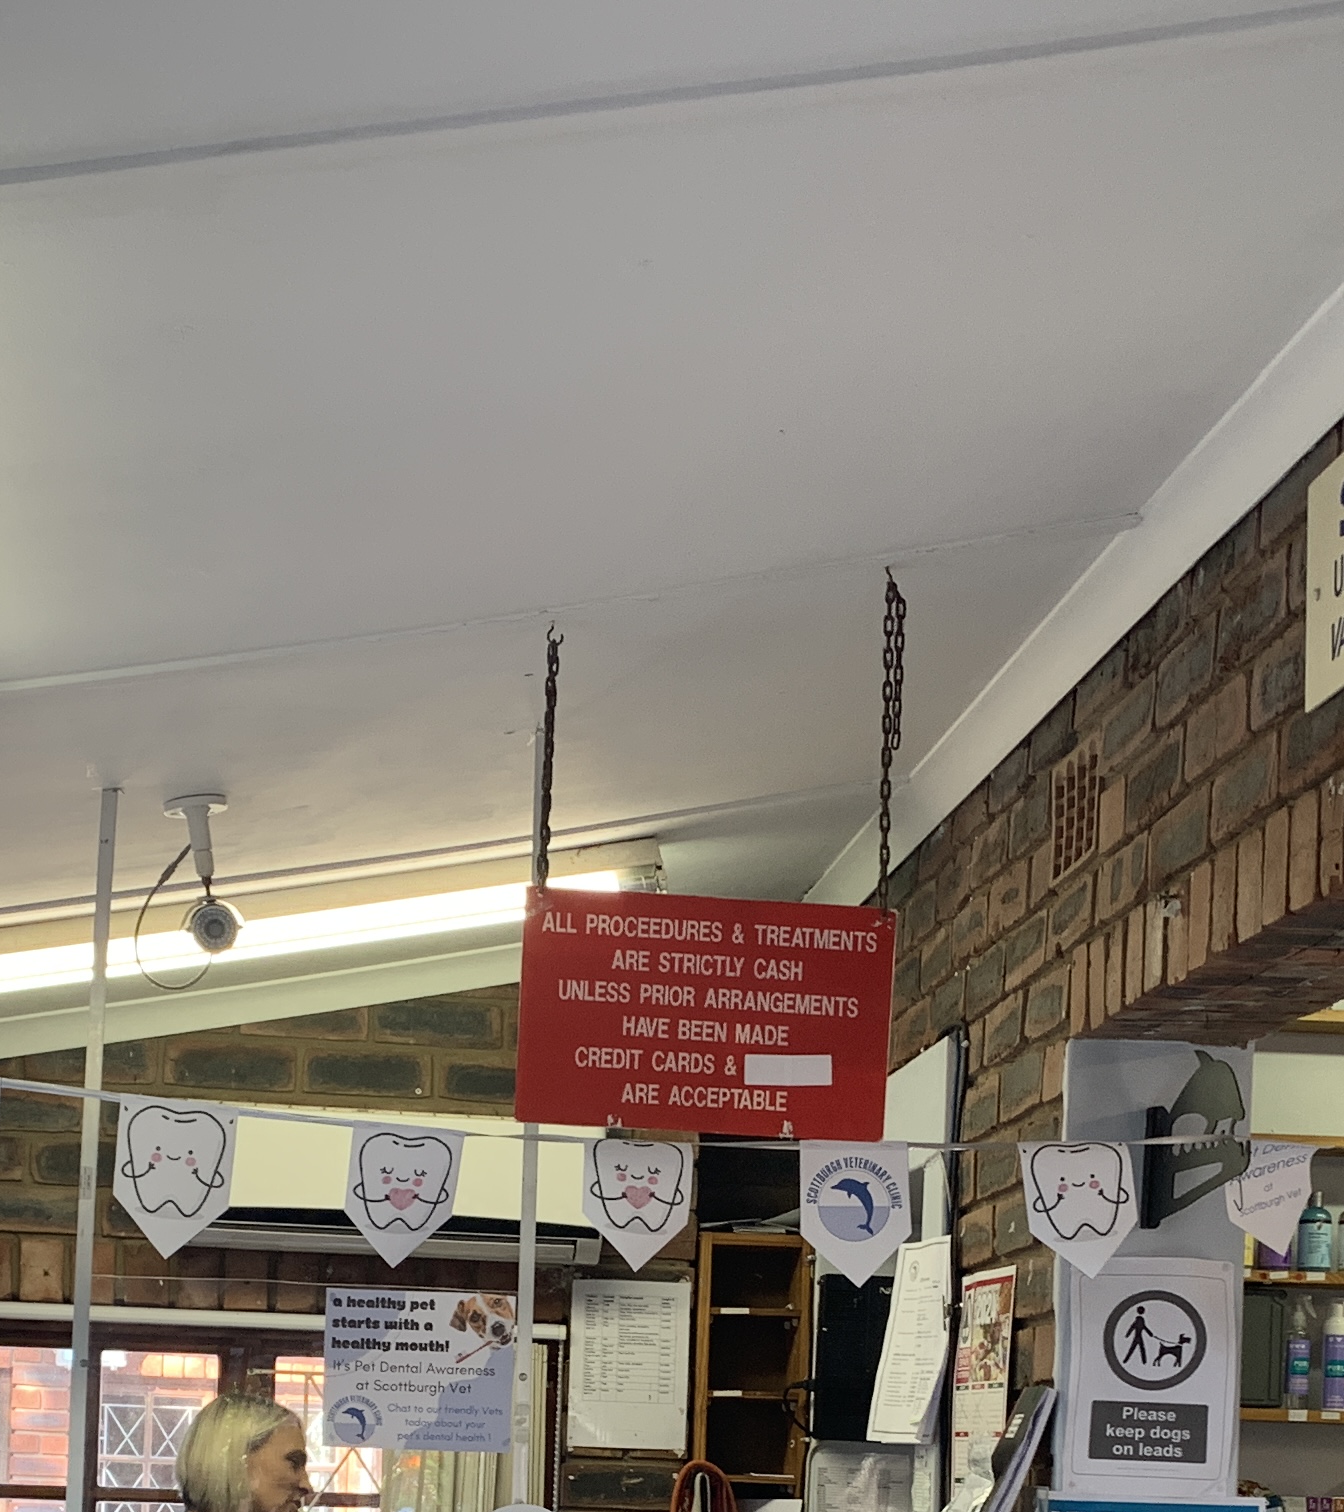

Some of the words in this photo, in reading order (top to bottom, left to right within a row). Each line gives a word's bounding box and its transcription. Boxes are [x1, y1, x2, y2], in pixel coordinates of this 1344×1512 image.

[542, 911, 577, 934] ALL
[586, 914, 722, 942] PROCEEDURES
[732, 924, 745, 944] &
[755, 924, 878, 953] TREATMENTS
[612, 950, 650, 971] ARE
[658, 952, 745, 978] STRICTLY
[754, 958, 803, 981] CASH
[558, 979, 630, 1003] UNLESS
[640, 983, 695, 1008] PRIOR
[705, 991, 859, 1018] ARRANGEMENTS
[622, 1016, 670, 1039] HAVE
[678, 1021, 727, 1042] BEEN
[735, 1024, 789, 1046] MADE
[574, 1046, 644, 1069] CREDIT
[652, 1051, 715, 1074] CARDS
[724, 1056, 737, 1076] &
[622, 1084, 660, 1105] ARE
[668, 1087, 788, 1112] ACCEPTABLE
[805, 1158, 843, 1206] SCOTTBURGH
[843, 1155, 893, 1186] VETERINARY
[888, 1180, 903, 1211] CLINIC
[333, 1297, 343, 1308] a
[347, 1296, 406, 1311] healthy
[410, 1299, 435, 1312] pet
[332, 1317, 380, 1330] starts
[384, 1319, 420, 1331] with
[423, 1323, 433, 1331] a
[331, 1337, 391, 1352] healthy
[395, 1340, 450, 1352] mouth!
[333, 1360, 350, 1372] It's
[355, 1361, 375, 1372] Pet
[380, 1361, 422, 1374] Dental
[426, 1363, 495, 1376] Awareness
[356, 1381, 369, 1390] at
[374, 1380, 444, 1396] Scottburgh
[449, 1383, 472, 1394] Vet
[1123, 1407, 1176, 1421] Please
[1106, 1424, 1145, 1440] keep
[1150, 1426, 1191, 1442] dogs
[1112, 1445, 1133, 1455] on
[1139, 1444, 1183, 1458] leads
